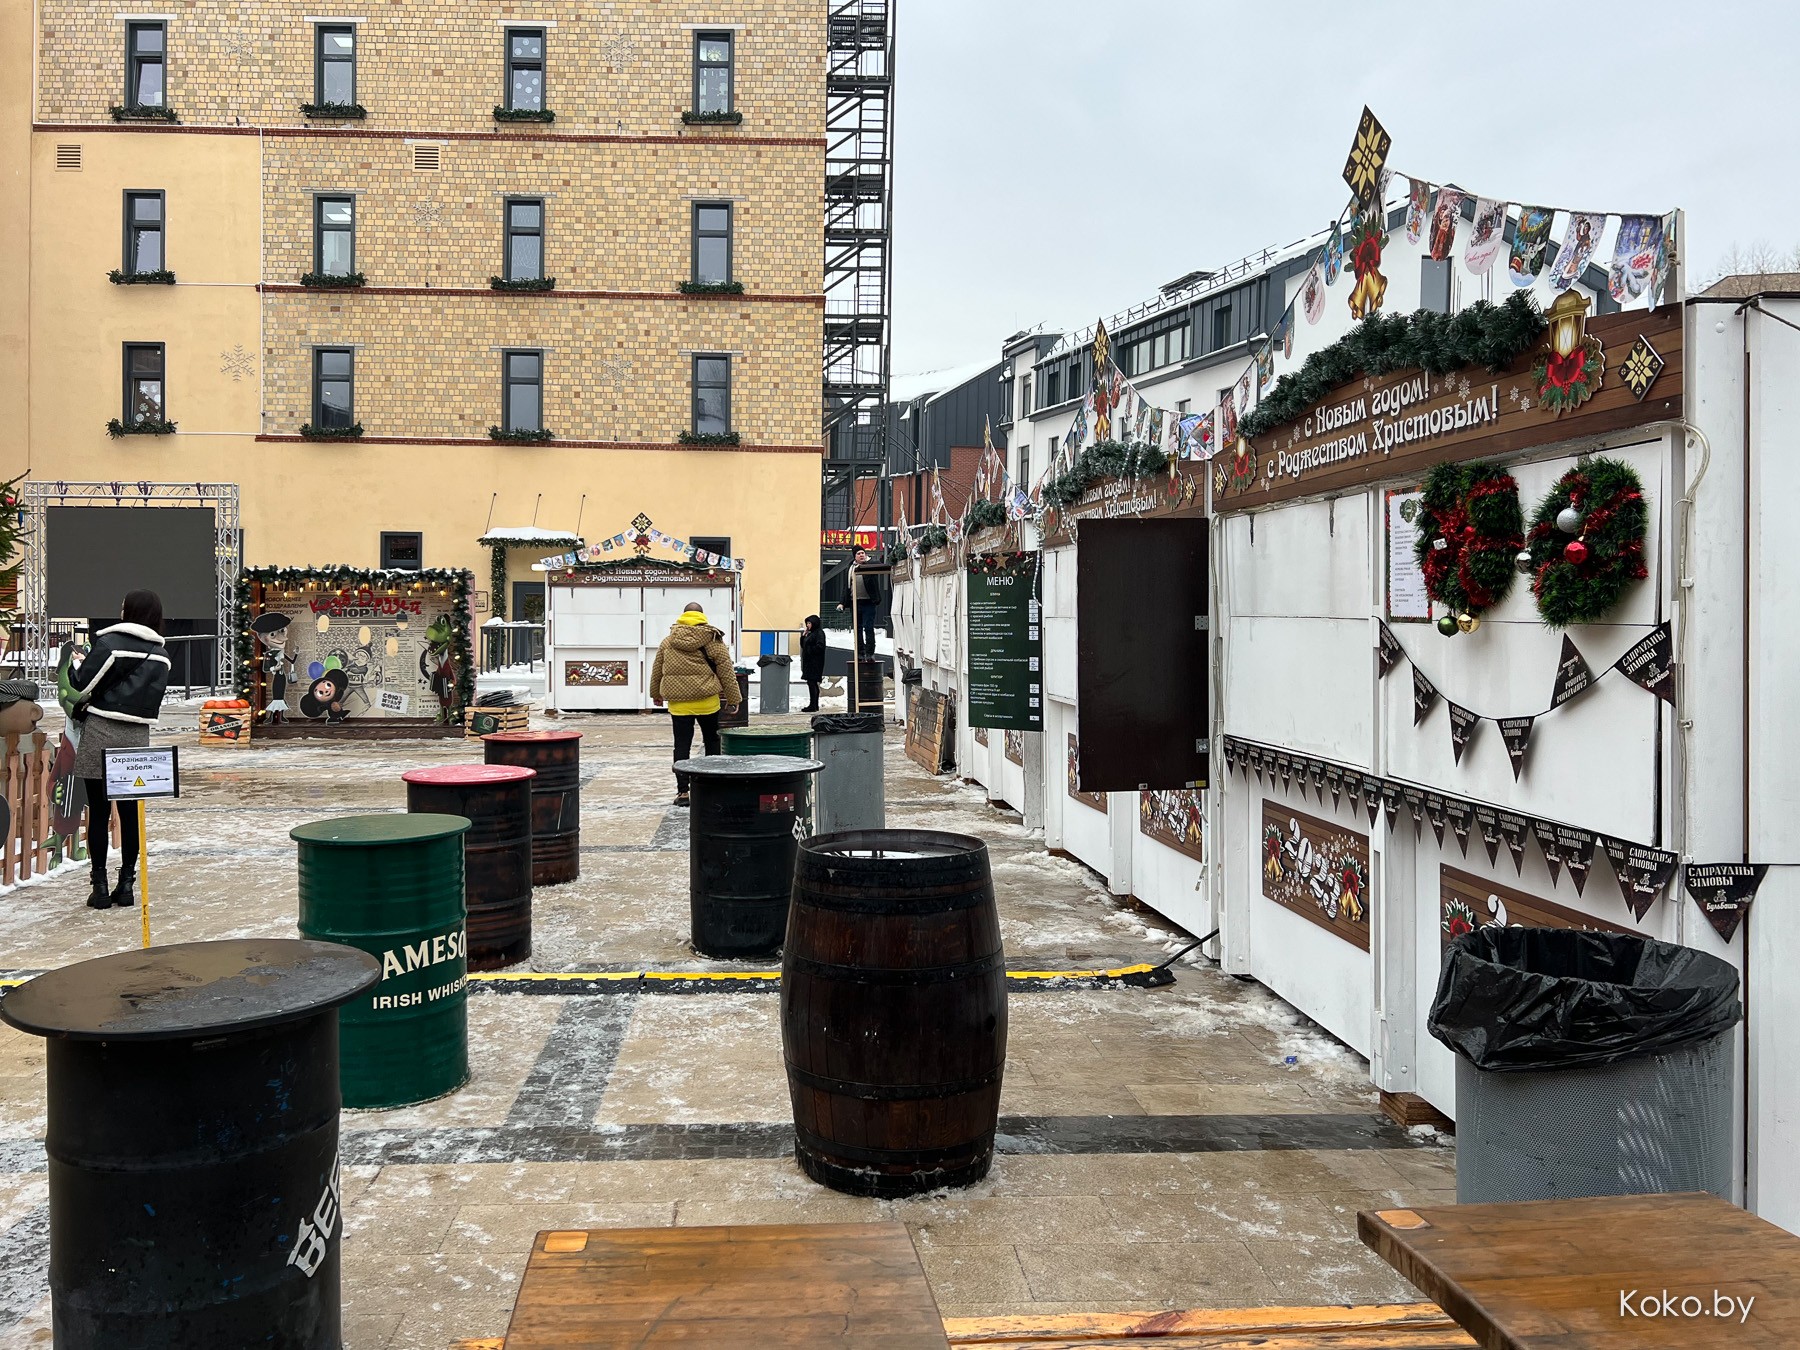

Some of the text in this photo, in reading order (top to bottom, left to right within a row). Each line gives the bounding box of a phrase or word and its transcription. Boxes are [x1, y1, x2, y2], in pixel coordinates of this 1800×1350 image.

[1304, 369, 1430, 438] с Новым годом!
[1267, 459, 1275, 479] с
[1372, 384, 1500, 455] Христовым!
[986, 576, 1014, 586] МЕНЮ
[579, 661, 613, 683] 2023
[210, 721, 240, 732] ORANGES
[111, 756, 149, 765] Охранная
[1284, 817, 1341, 919] 2023
[1689, 876, 1734, 888] ЗІМОВЫ
[381, 929, 467, 981] AMESO
[372, 974, 468, 1010] IRISH WHISKE
[286, 1150, 340, 1279] BEE
